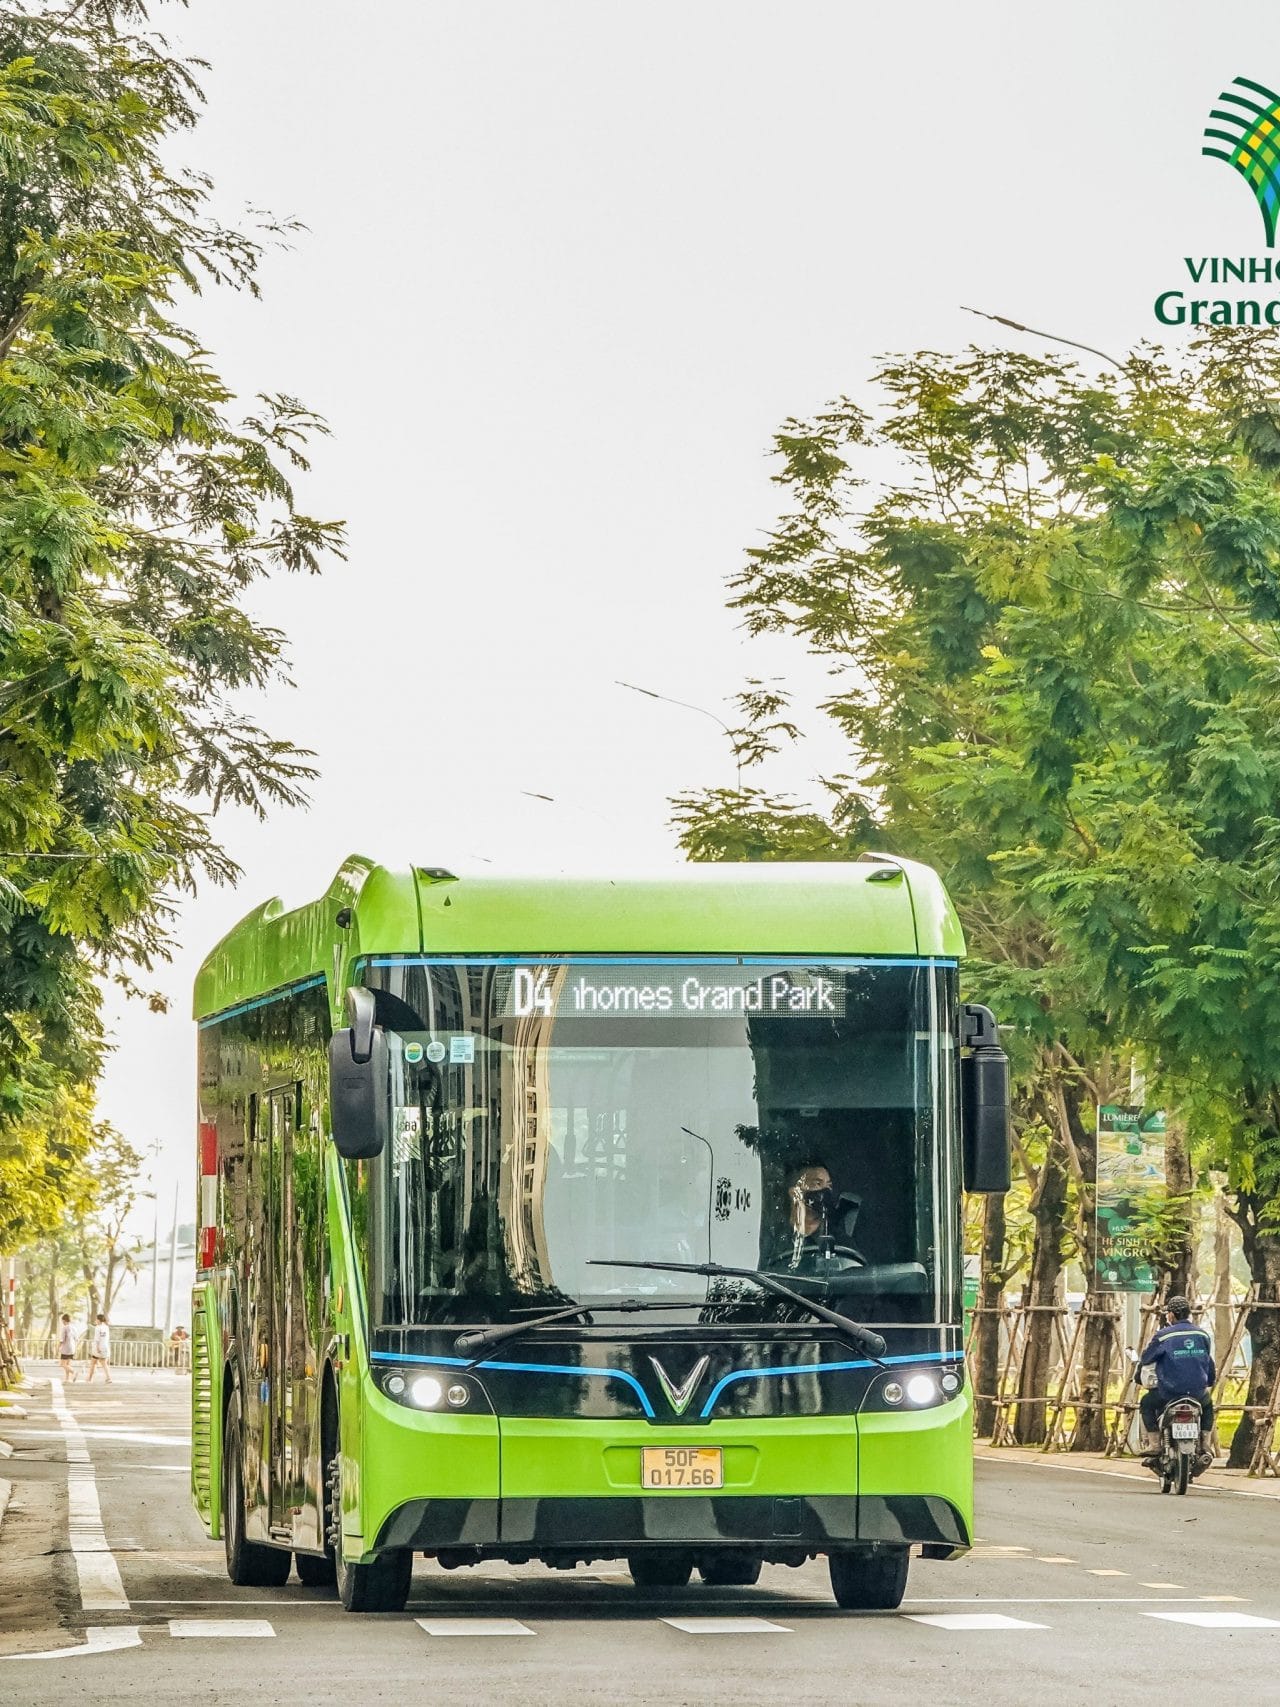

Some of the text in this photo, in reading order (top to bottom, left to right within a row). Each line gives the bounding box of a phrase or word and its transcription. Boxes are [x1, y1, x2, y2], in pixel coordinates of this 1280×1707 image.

[515, 969, 553, 1016] D4
[682, 977, 762, 1010] Grand
[771, 977, 836, 1010] Park
[665, 1450, 700, 1466] 50F
[651, 1469, 714, 1485] 017.66
